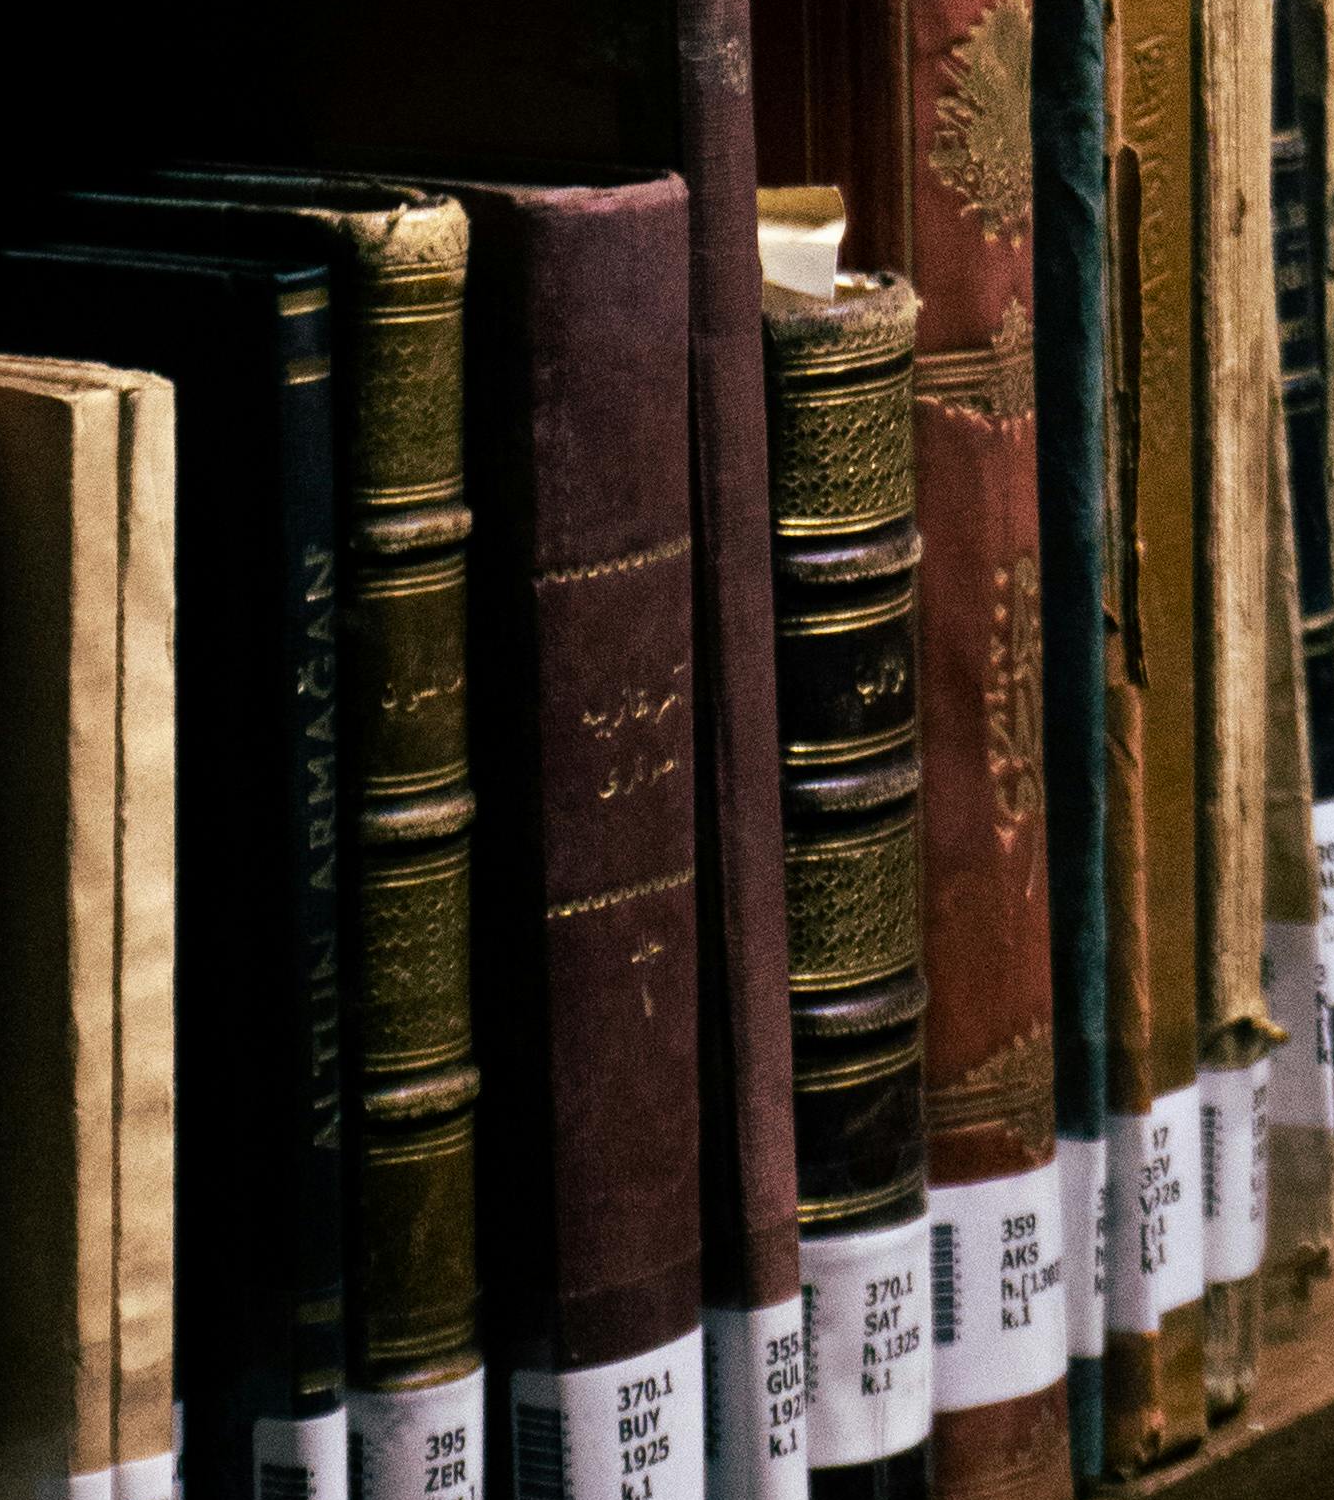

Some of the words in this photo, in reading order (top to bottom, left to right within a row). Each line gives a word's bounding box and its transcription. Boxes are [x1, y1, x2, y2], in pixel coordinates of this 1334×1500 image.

[1000, 1212, 1037, 1244] 359
[1000, 1241, 1039, 1272] AKS
[865, 1270, 914, 1307] 370.1
[864, 1304, 902, 1337] SAT
[1001, 1303, 1032, 1331] k.1
[617, 1369, 674, 1412] 370.1
[861, 1367, 893, 1396] k.1
[618, 1406, 661, 1444] BUY
[425, 1424, 467, 1462] 395
[620, 1434, 670, 1476] 1925
[768, 1428, 798, 1459] k.1
[424, 1458, 467, 1494] ZER
